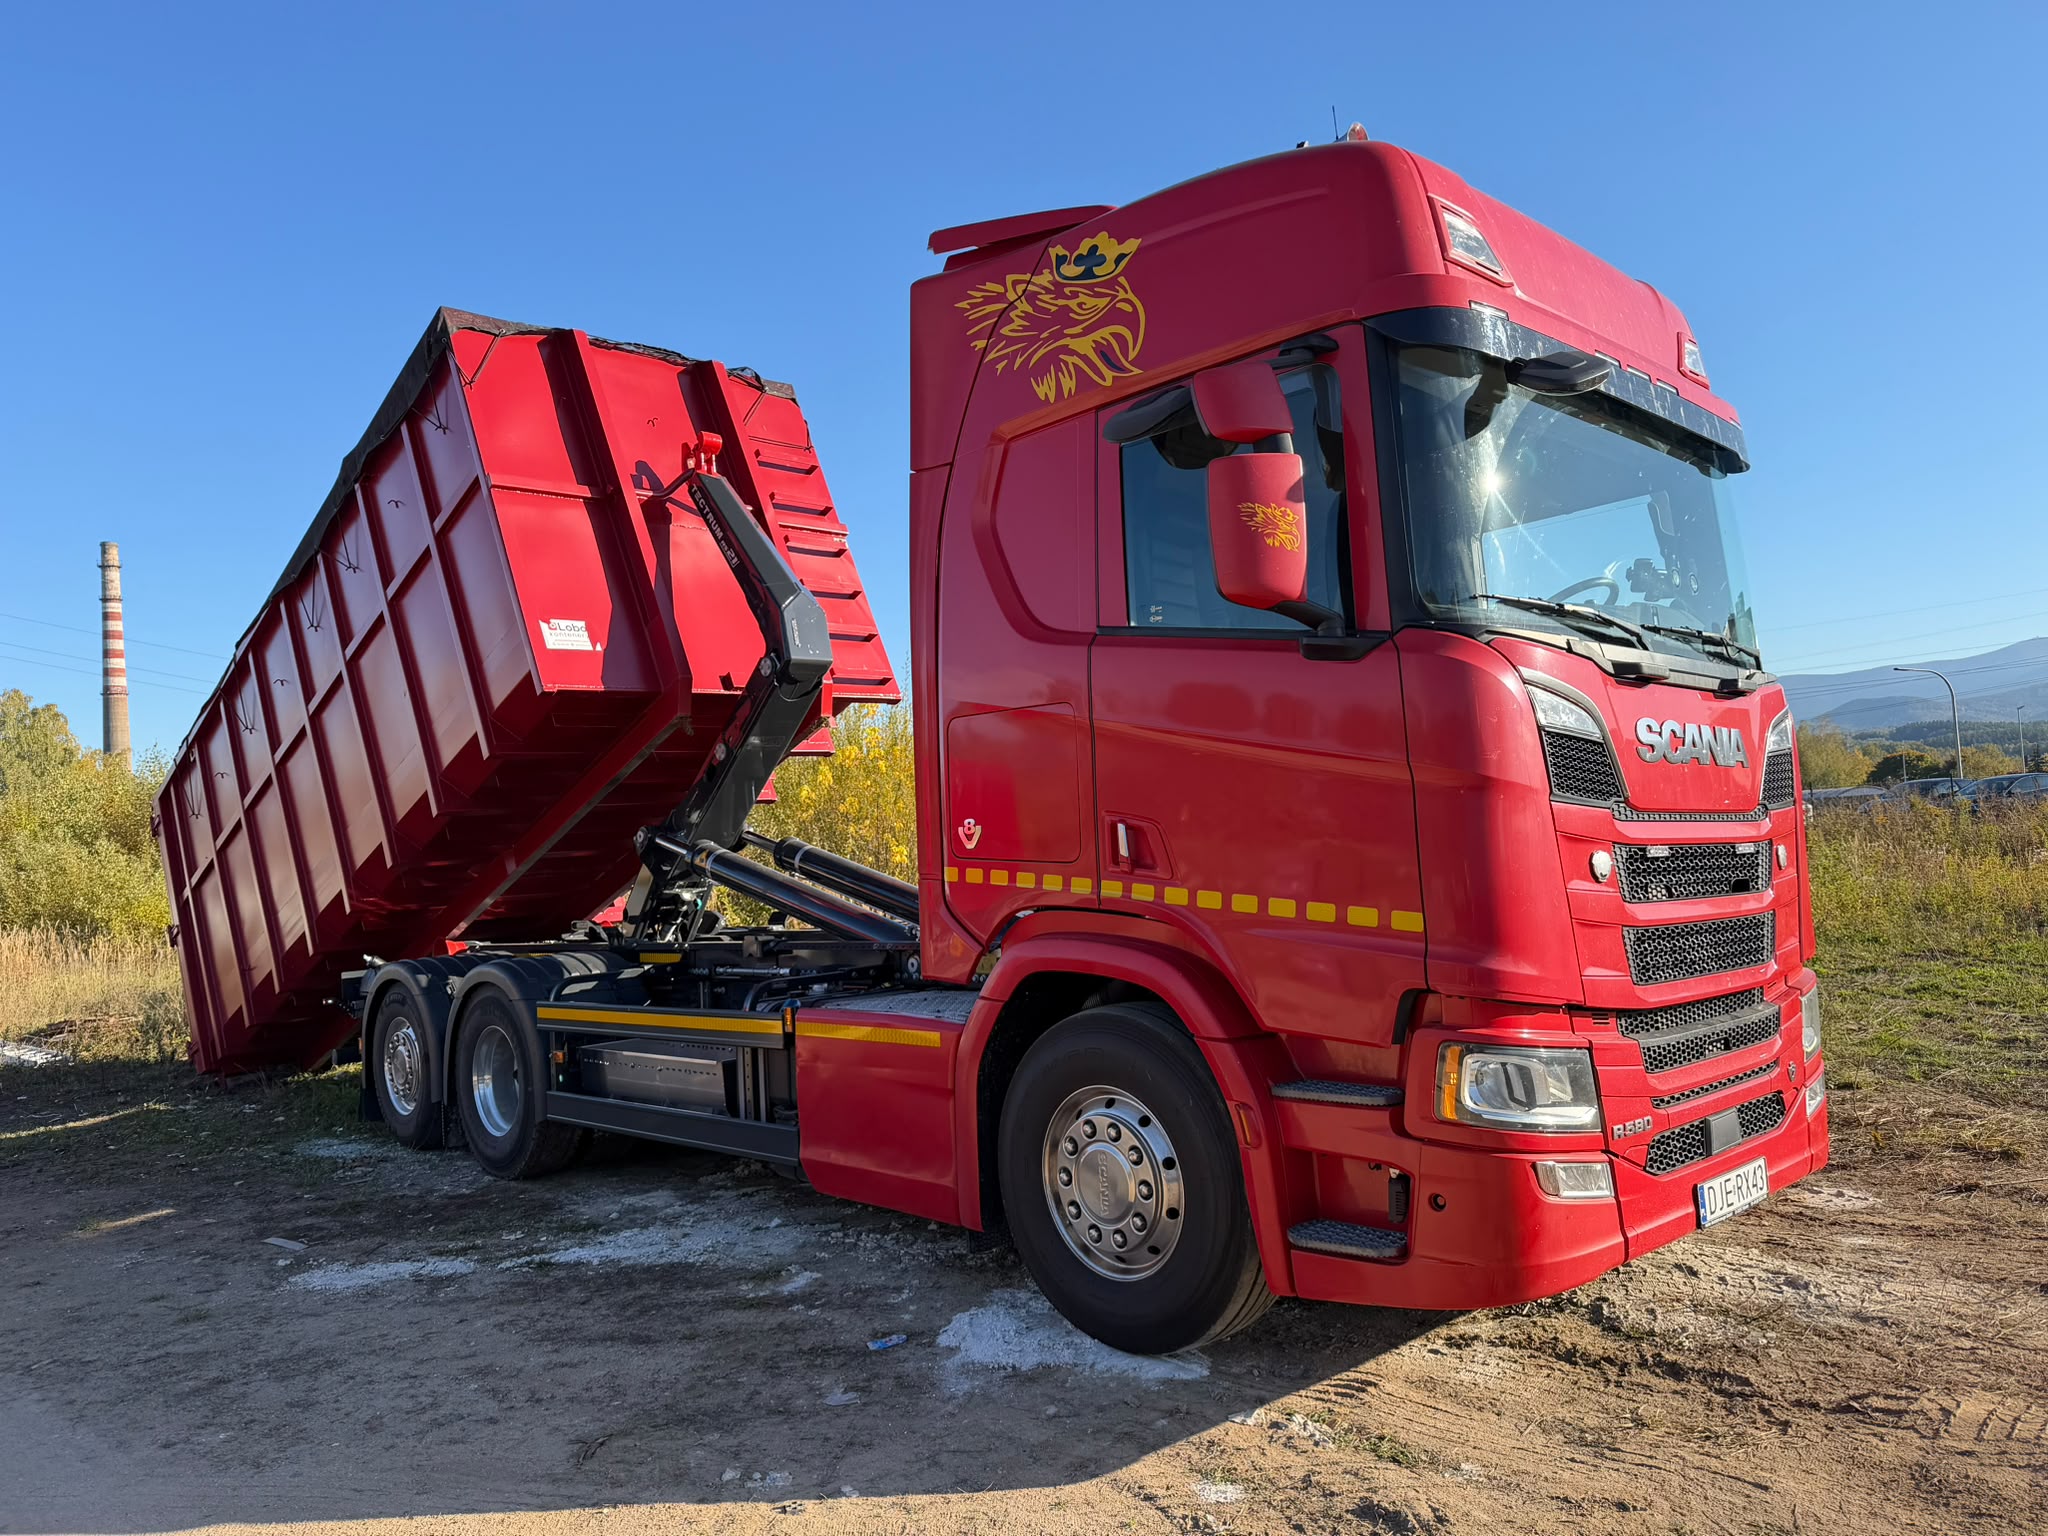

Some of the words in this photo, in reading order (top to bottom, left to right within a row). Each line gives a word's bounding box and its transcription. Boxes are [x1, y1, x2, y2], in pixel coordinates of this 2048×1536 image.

[691, 484, 723, 541] TECTRUM
[1635, 717, 1749, 768] SCANIA
[1612, 1116, 1653, 1140] R580
[1097, 1152, 1110, 1217] SCANIA
